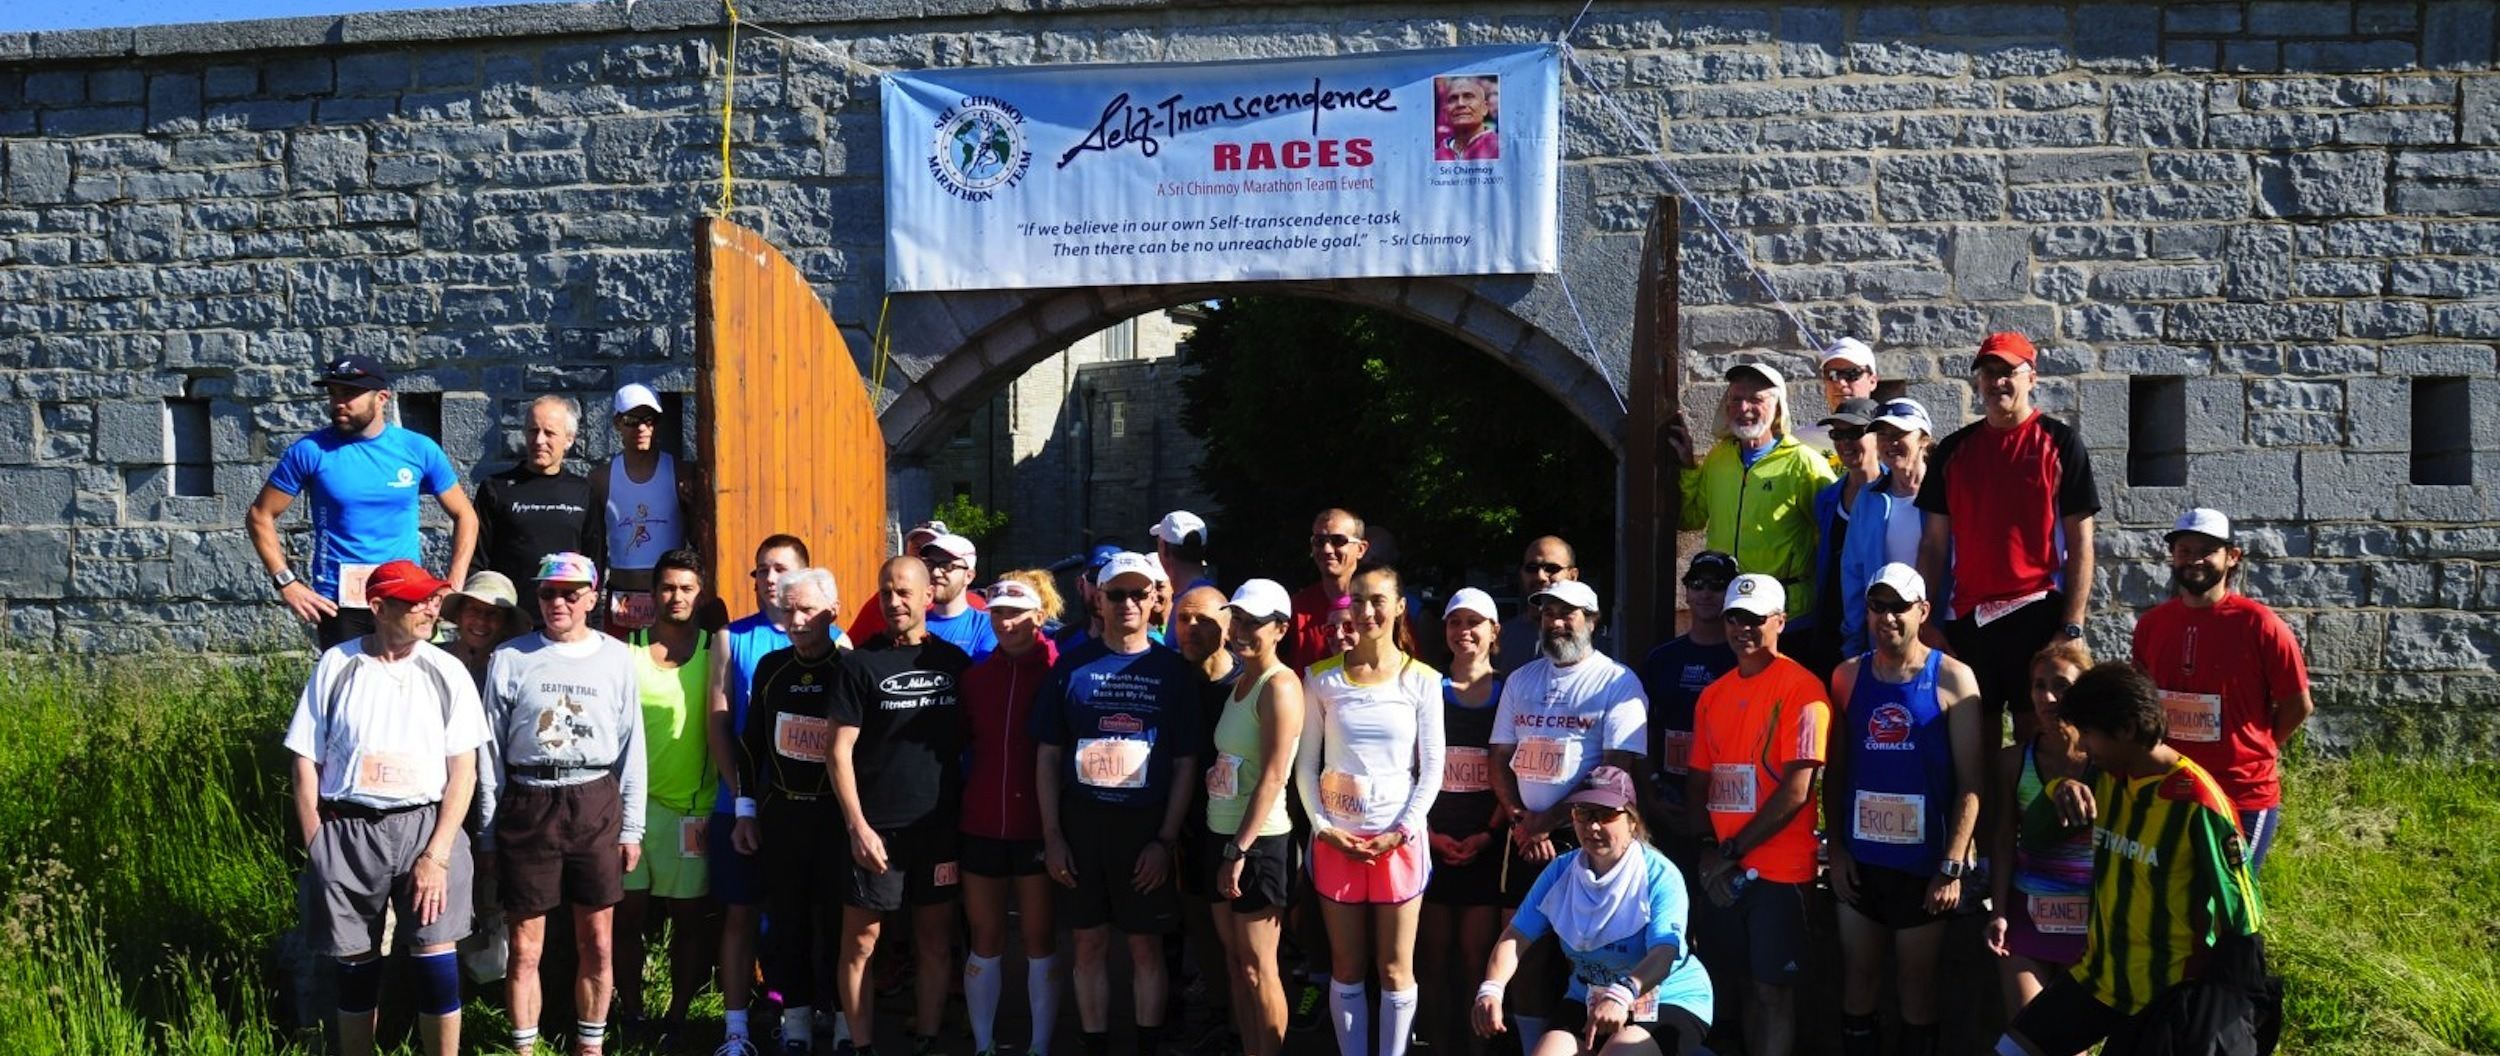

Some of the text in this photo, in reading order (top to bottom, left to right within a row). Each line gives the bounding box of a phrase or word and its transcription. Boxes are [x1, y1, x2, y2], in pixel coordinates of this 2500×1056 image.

[934, 96, 1027, 131] SRI CHINMOY
[1213, 138, 1374, 171] RACES
[927, 150, 1033, 202] MARATHON TEAM
[1453, 166, 1493, 176] Chinmoy
[1157, 177, 1375, 198] A Sri Chinmoy Marathon Team Event
[1038, 224, 1060, 236] we
[1064, 220, 1119, 235] believe
[1122, 219, 1137, 233] in
[1141, 220, 1168, 232] our
[1171, 219, 1205, 231] own
[1209, 210, 1400, 230] Self-transcendence-task
[1053, 243, 1090, 256] Then
[1094, 241, 1135, 255] there
[1139, 242, 1167, 254] can
[1171, 239, 1190, 252] be
[1193, 240, 1214, 251] no
[1218, 235, 1318, 251] unreachable
[1391, 234, 1408, 246] Sri
[1412, 233, 1471, 247] Chinmoy
[541, 683, 574, 694] SEATON
[1546, 715, 1593, 730] CREW
[1865, 742, 1915, 751] CORIACES
[1088, 752, 1133, 777] PAUL
[1513, 749, 1565, 775] ELLIOT
[1711, 776, 1745, 801] OHN
[1859, 806, 1894, 833] ERIC
